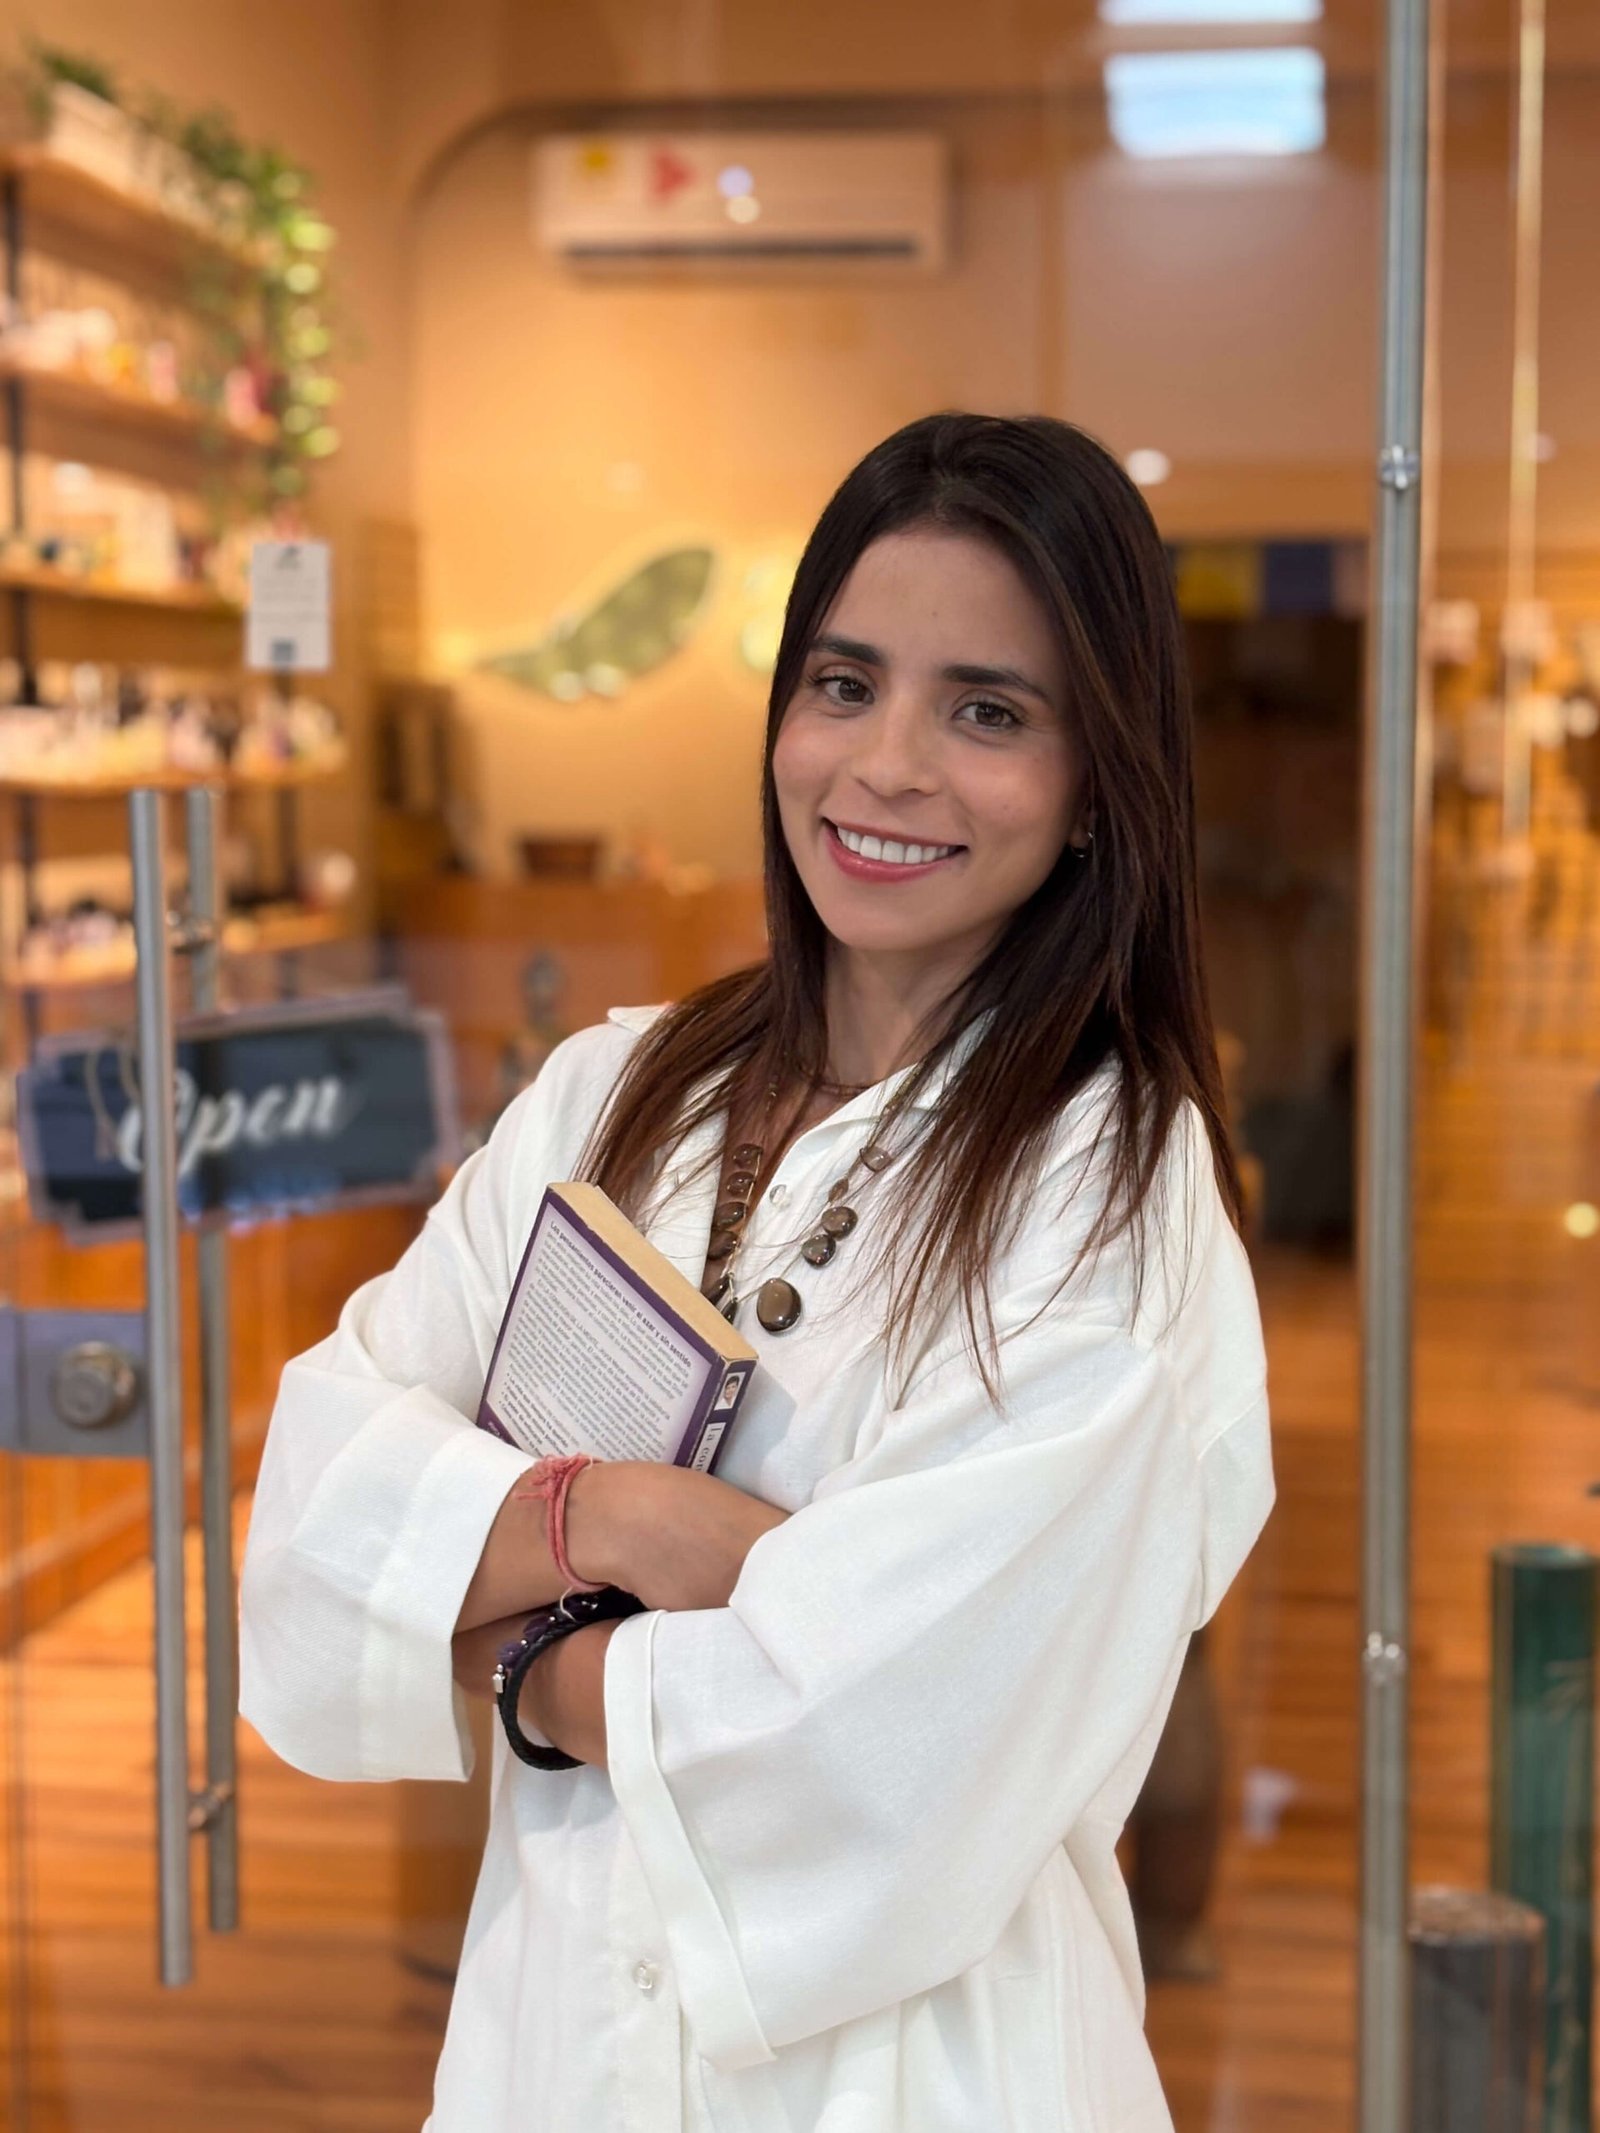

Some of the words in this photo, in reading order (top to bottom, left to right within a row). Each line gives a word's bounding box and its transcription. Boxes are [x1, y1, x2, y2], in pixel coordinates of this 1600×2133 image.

[118, 1067, 344, 1176] Open
[549, 1220, 560, 1235] Los
[559, 1232, 594, 1271] pensamientos
[622, 1296, 636, 1313] venir
[660, 1334, 670, 1347] sin
